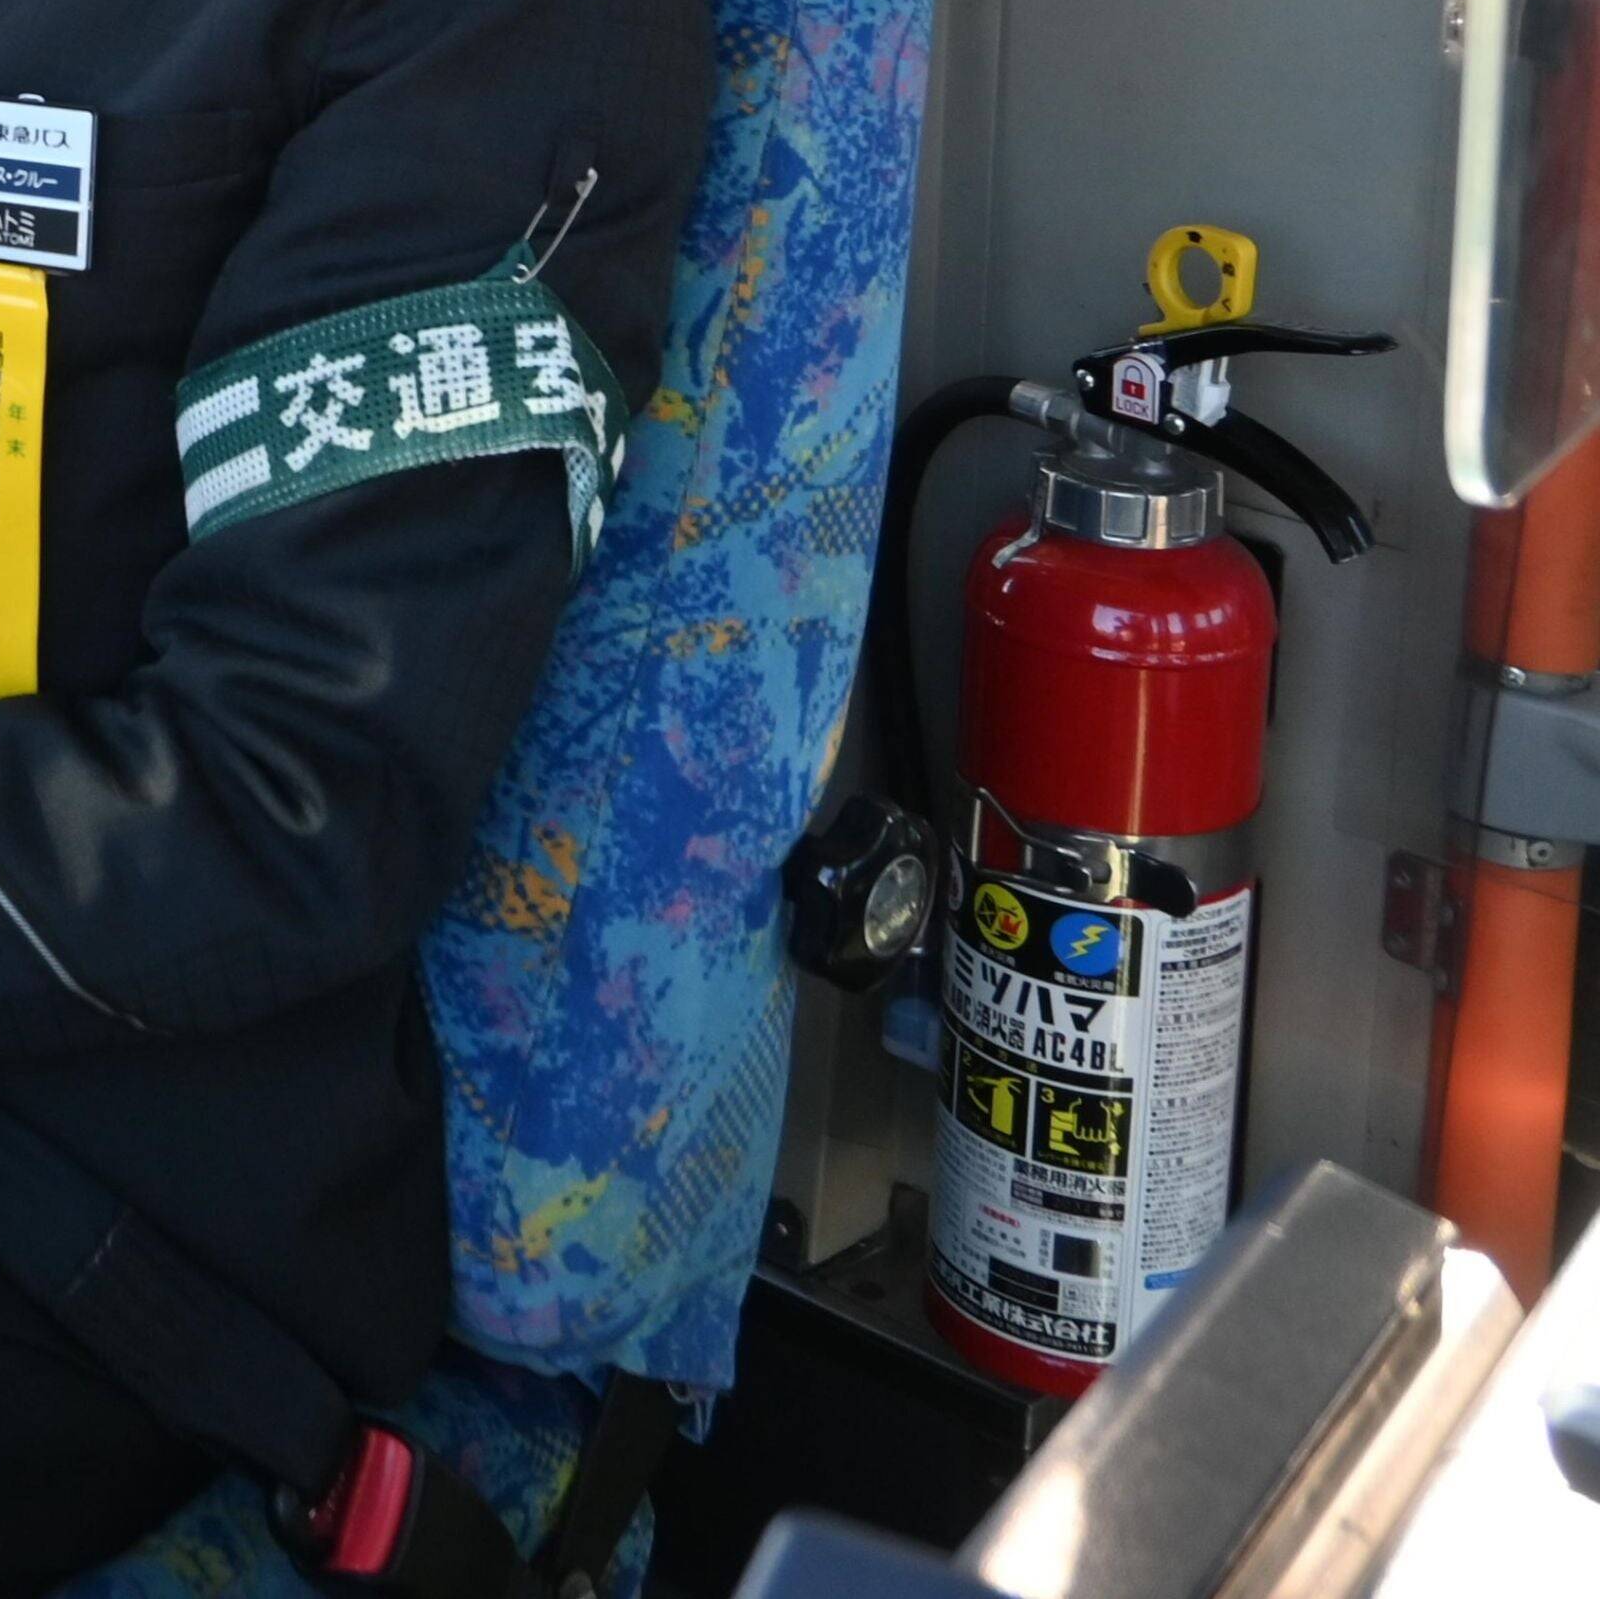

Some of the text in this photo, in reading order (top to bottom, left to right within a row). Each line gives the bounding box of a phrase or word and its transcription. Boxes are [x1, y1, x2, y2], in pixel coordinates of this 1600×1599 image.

[7, 402, 27, 458] 年末
[1115, 397, 1150, 418] LOCK
[955, 941, 1107, 1034] ミツハマ
[1032, 1027, 1124, 1073] AC4BL
[1041, 1087, 1055, 1103] 3
